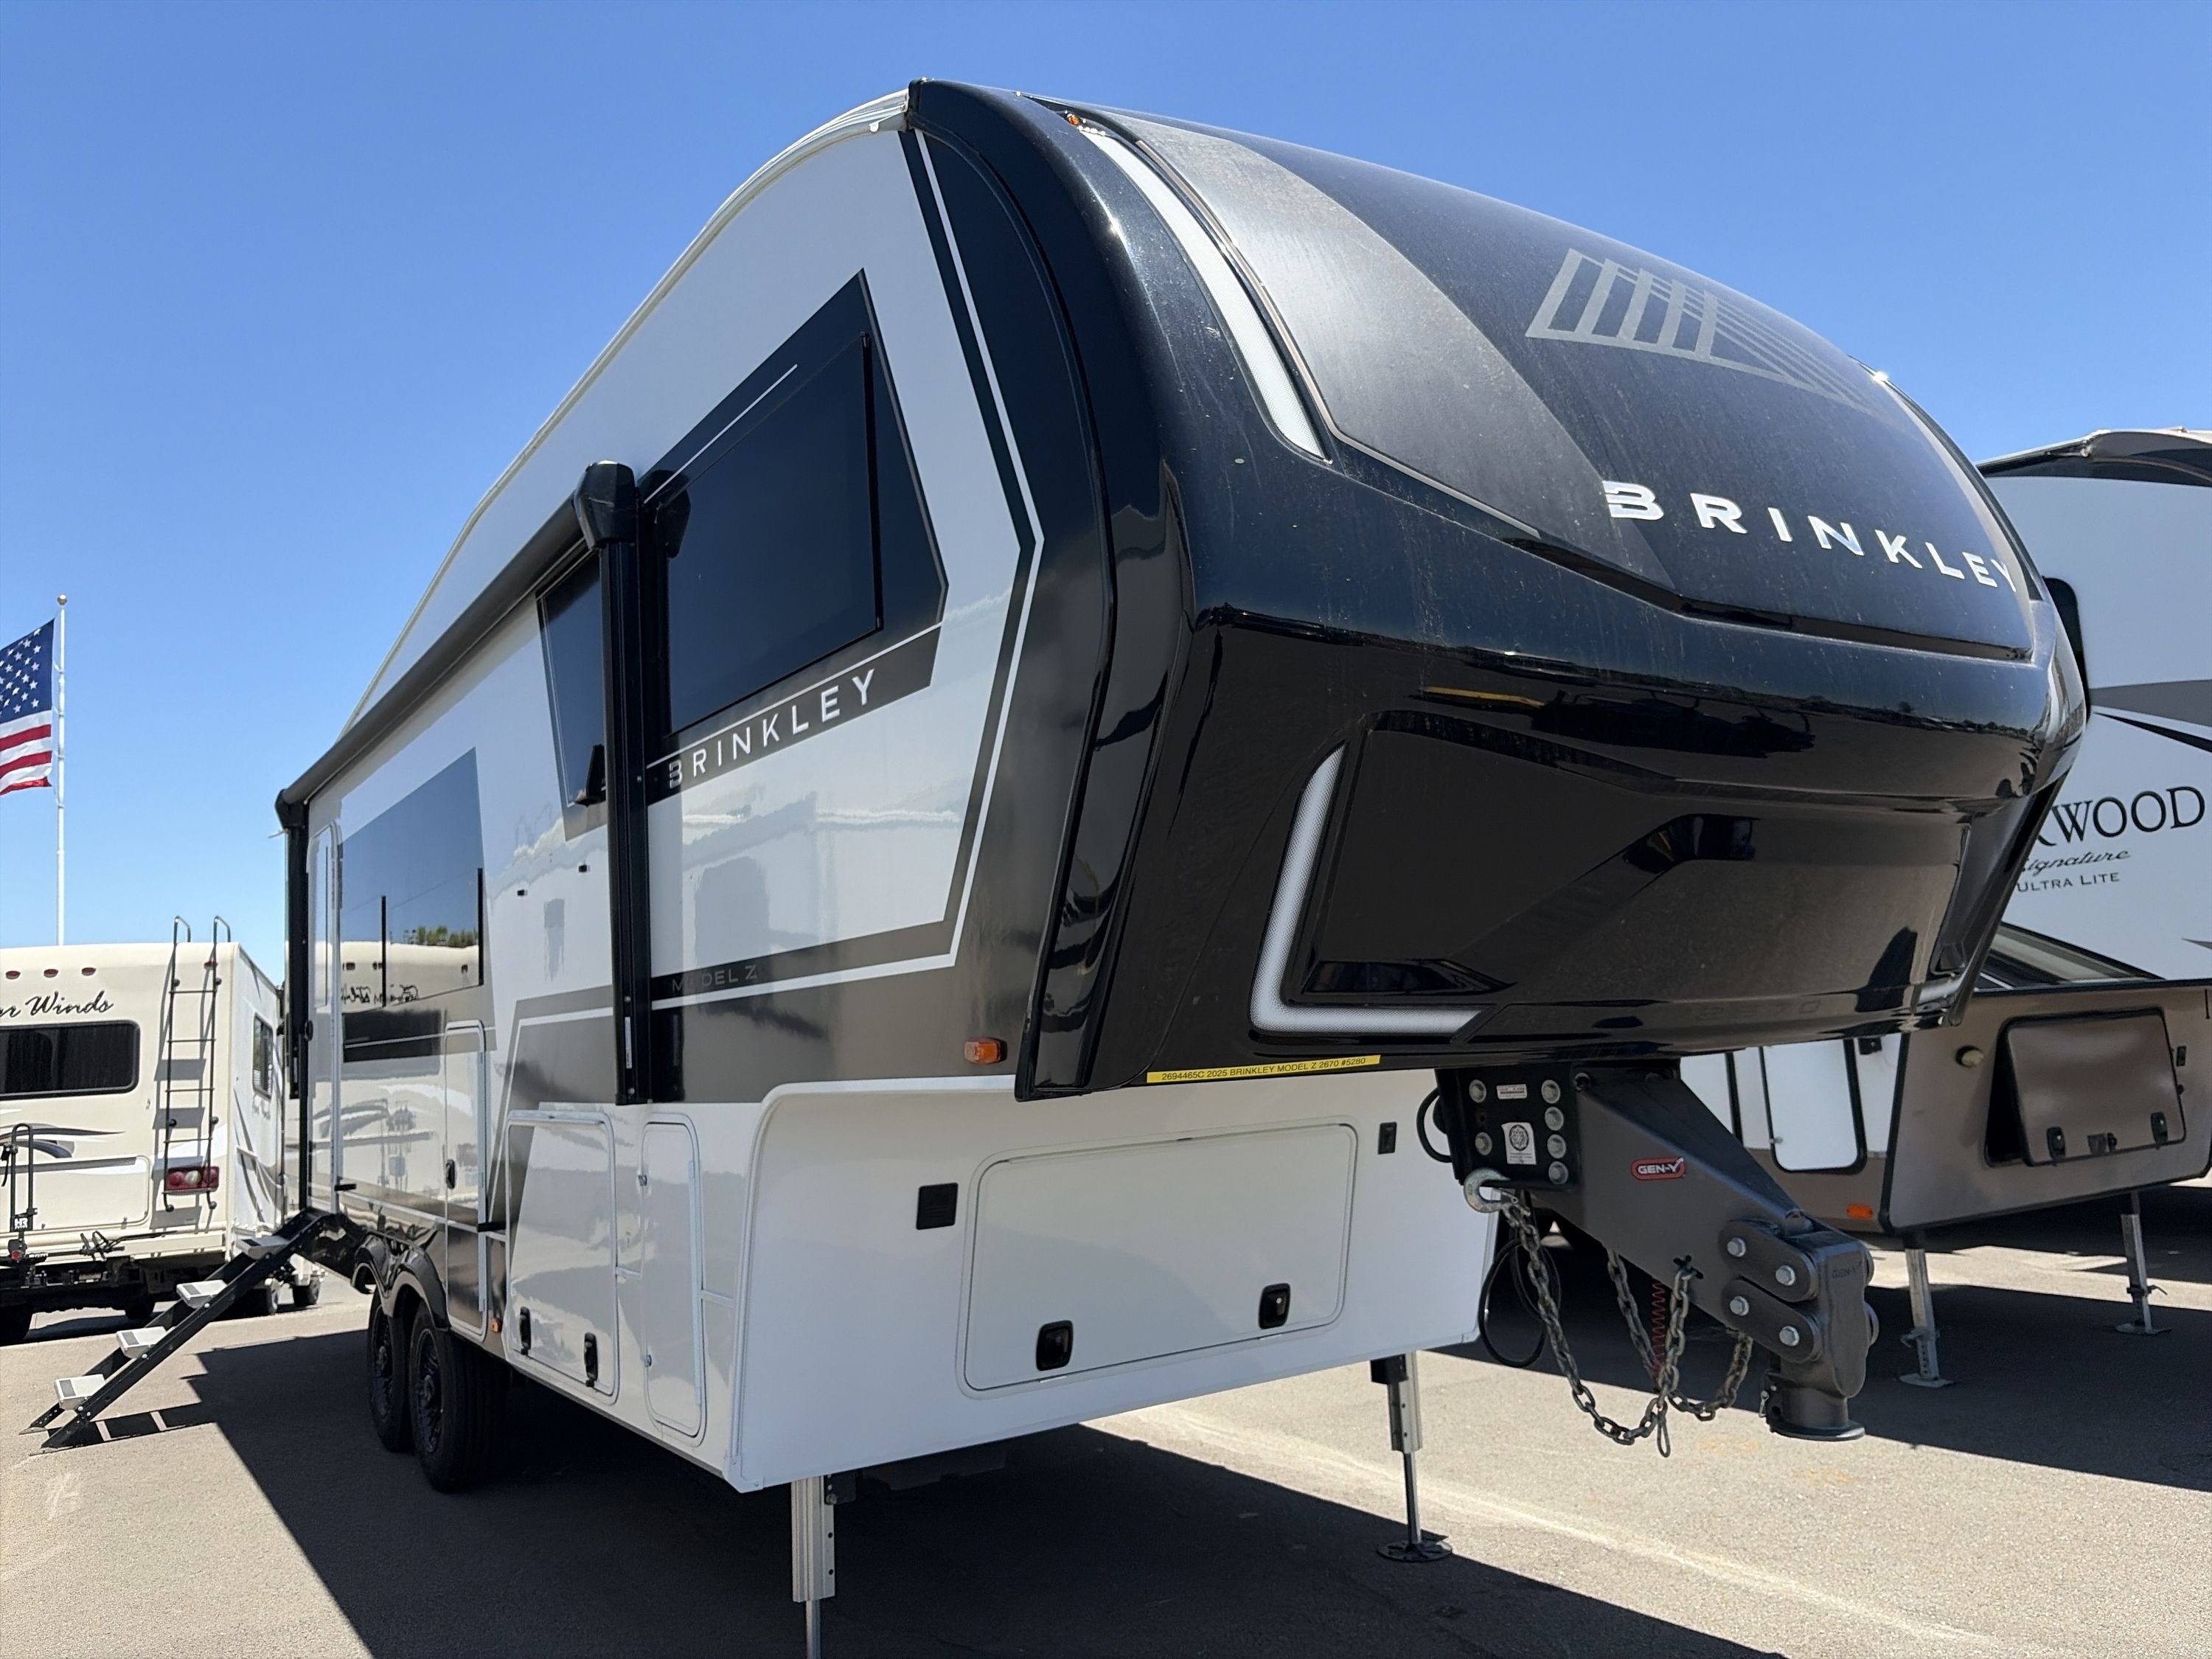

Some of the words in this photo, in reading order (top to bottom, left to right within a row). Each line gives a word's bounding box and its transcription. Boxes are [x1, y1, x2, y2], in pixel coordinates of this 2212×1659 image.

[1602, 480, 2017, 592] BRINKLEY
[668, 668, 875, 789] BRINKLEY
[2022, 849, 2131, 877] ignature
[2017, 877, 2073, 893] ULTRA
[2080, 872, 2121, 886] LITE
[745, 964, 758, 981] Z
[24, 990, 114, 1016] Winds
[1161, 1071, 1205, 1080] 2694465C
[1206, 1069, 1228, 1078] 2025
[1229, 1065, 1276, 1076] BRINKLEY
[1277, 1062, 1310, 1072] MODEL
[1318, 1060, 1339, 1068] 2670
[1341, 1057, 1366, 1066] #5280
[1638, 1158, 1684, 1175] GEN-Y
